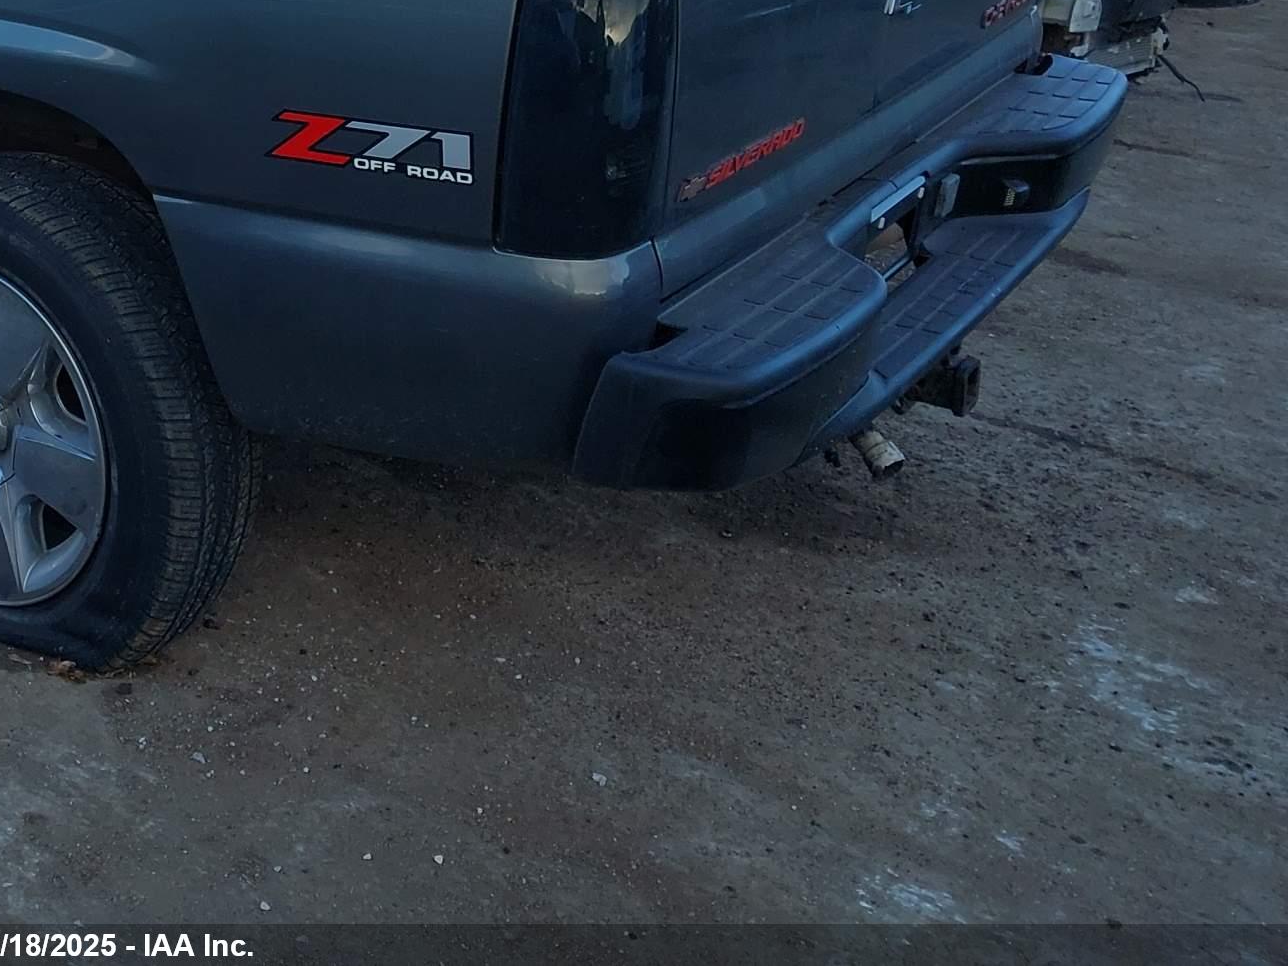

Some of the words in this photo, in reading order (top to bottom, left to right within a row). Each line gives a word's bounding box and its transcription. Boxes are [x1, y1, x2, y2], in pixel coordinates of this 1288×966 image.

[268, 110, 472, 171] Z71
[353, 156, 397, 173] OFF
[406, 165, 474, 185] ROAD
[704, 117, 805, 190] SILVERADO
